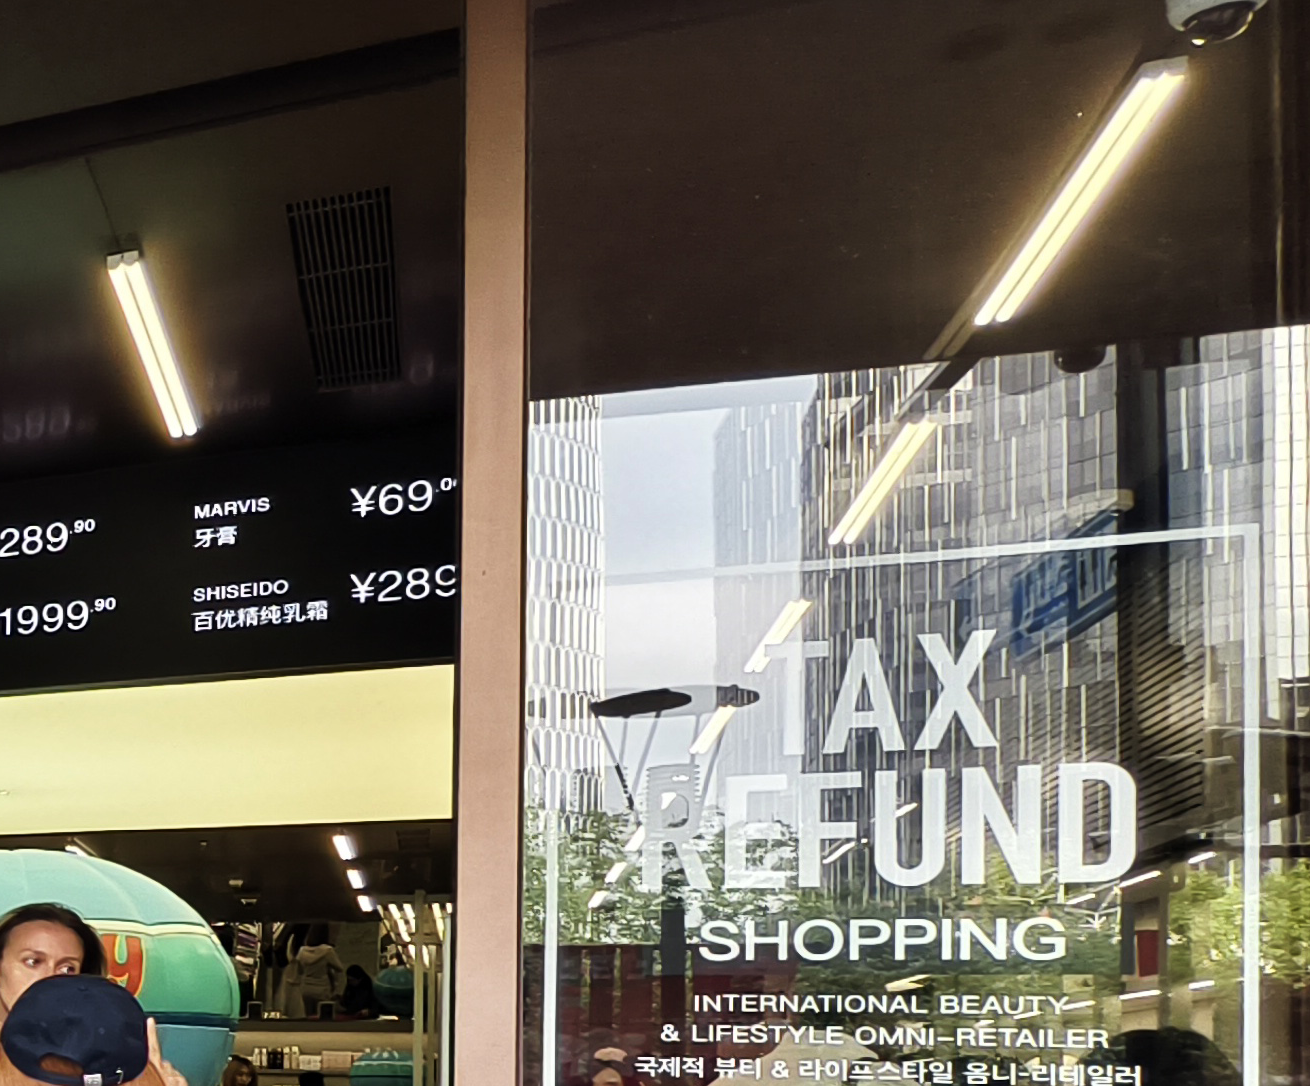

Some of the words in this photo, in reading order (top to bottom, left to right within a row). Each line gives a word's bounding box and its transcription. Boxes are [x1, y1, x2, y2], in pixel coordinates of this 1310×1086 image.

[193, 497, 270, 519] MARVIS
[192, 525, 238, 548] 牙膏
[192, 579, 289, 602] SHISEIDO
[192, 600, 328, 632] 百优精纯乳霜
[763, 628, 998, 757] TAX
[638, 761, 1138, 890] REFUND
[698, 917, 1068, 963] SHOPPING
[693, 994, 928, 1016] INTERNATIONAL
[939, 995, 1066, 1016] BEAUTY
[660, 1023, 681, 1044] &
[691, 1024, 846, 1045] LIFESTYLE
[634, 1056, 705, 1080] 국제적
[714, 1057, 762, 1081] 뷰티
[771, 1059, 790, 1079] &
[798, 1058, 955, 1086] 라이프스타일
